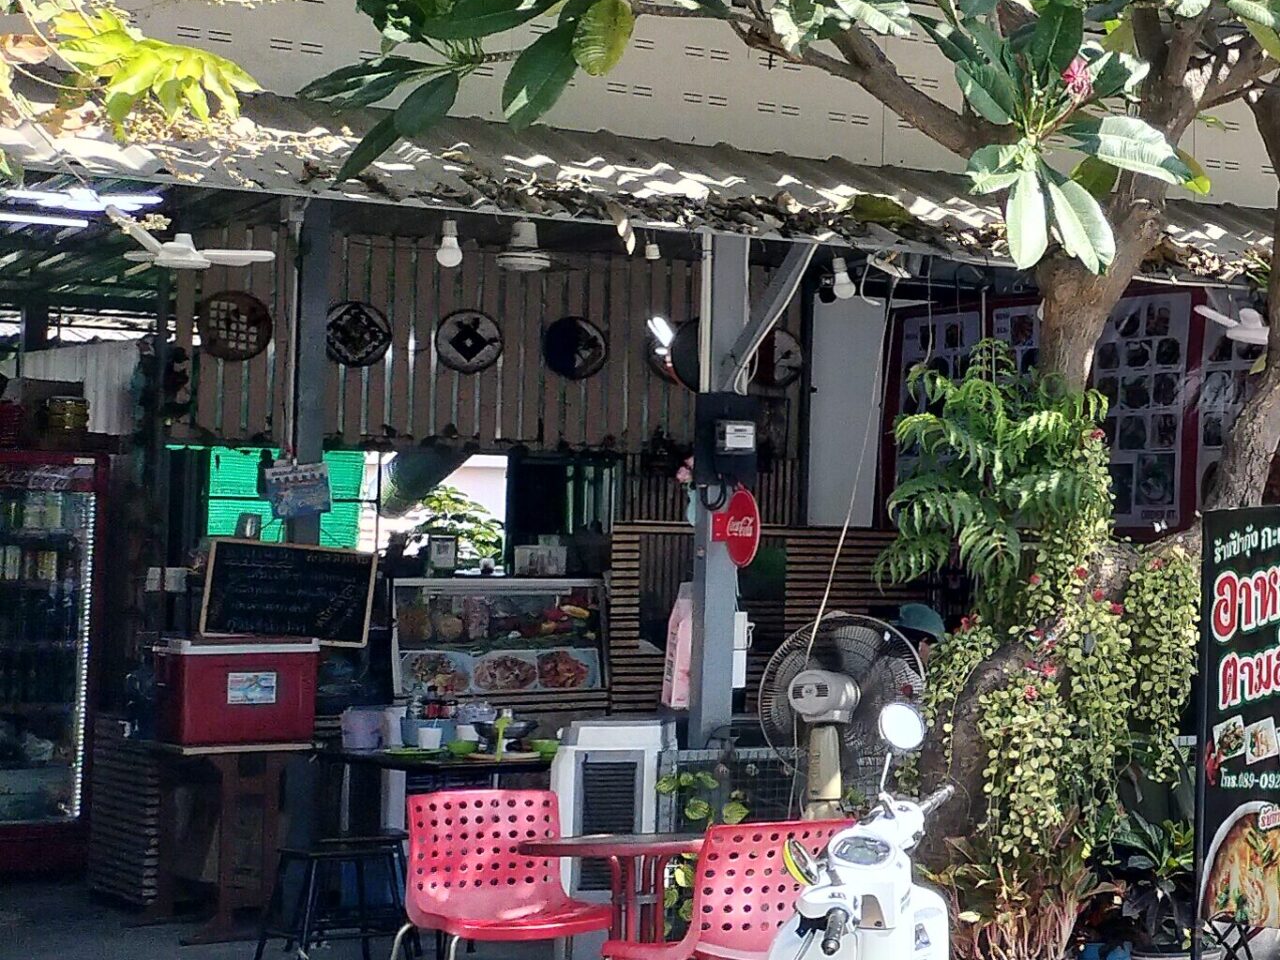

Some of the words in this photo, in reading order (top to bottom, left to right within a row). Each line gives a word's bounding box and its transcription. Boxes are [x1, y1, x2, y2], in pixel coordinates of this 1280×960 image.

[1214, 524, 1259, 564] ร้านป้ากุ้ง
